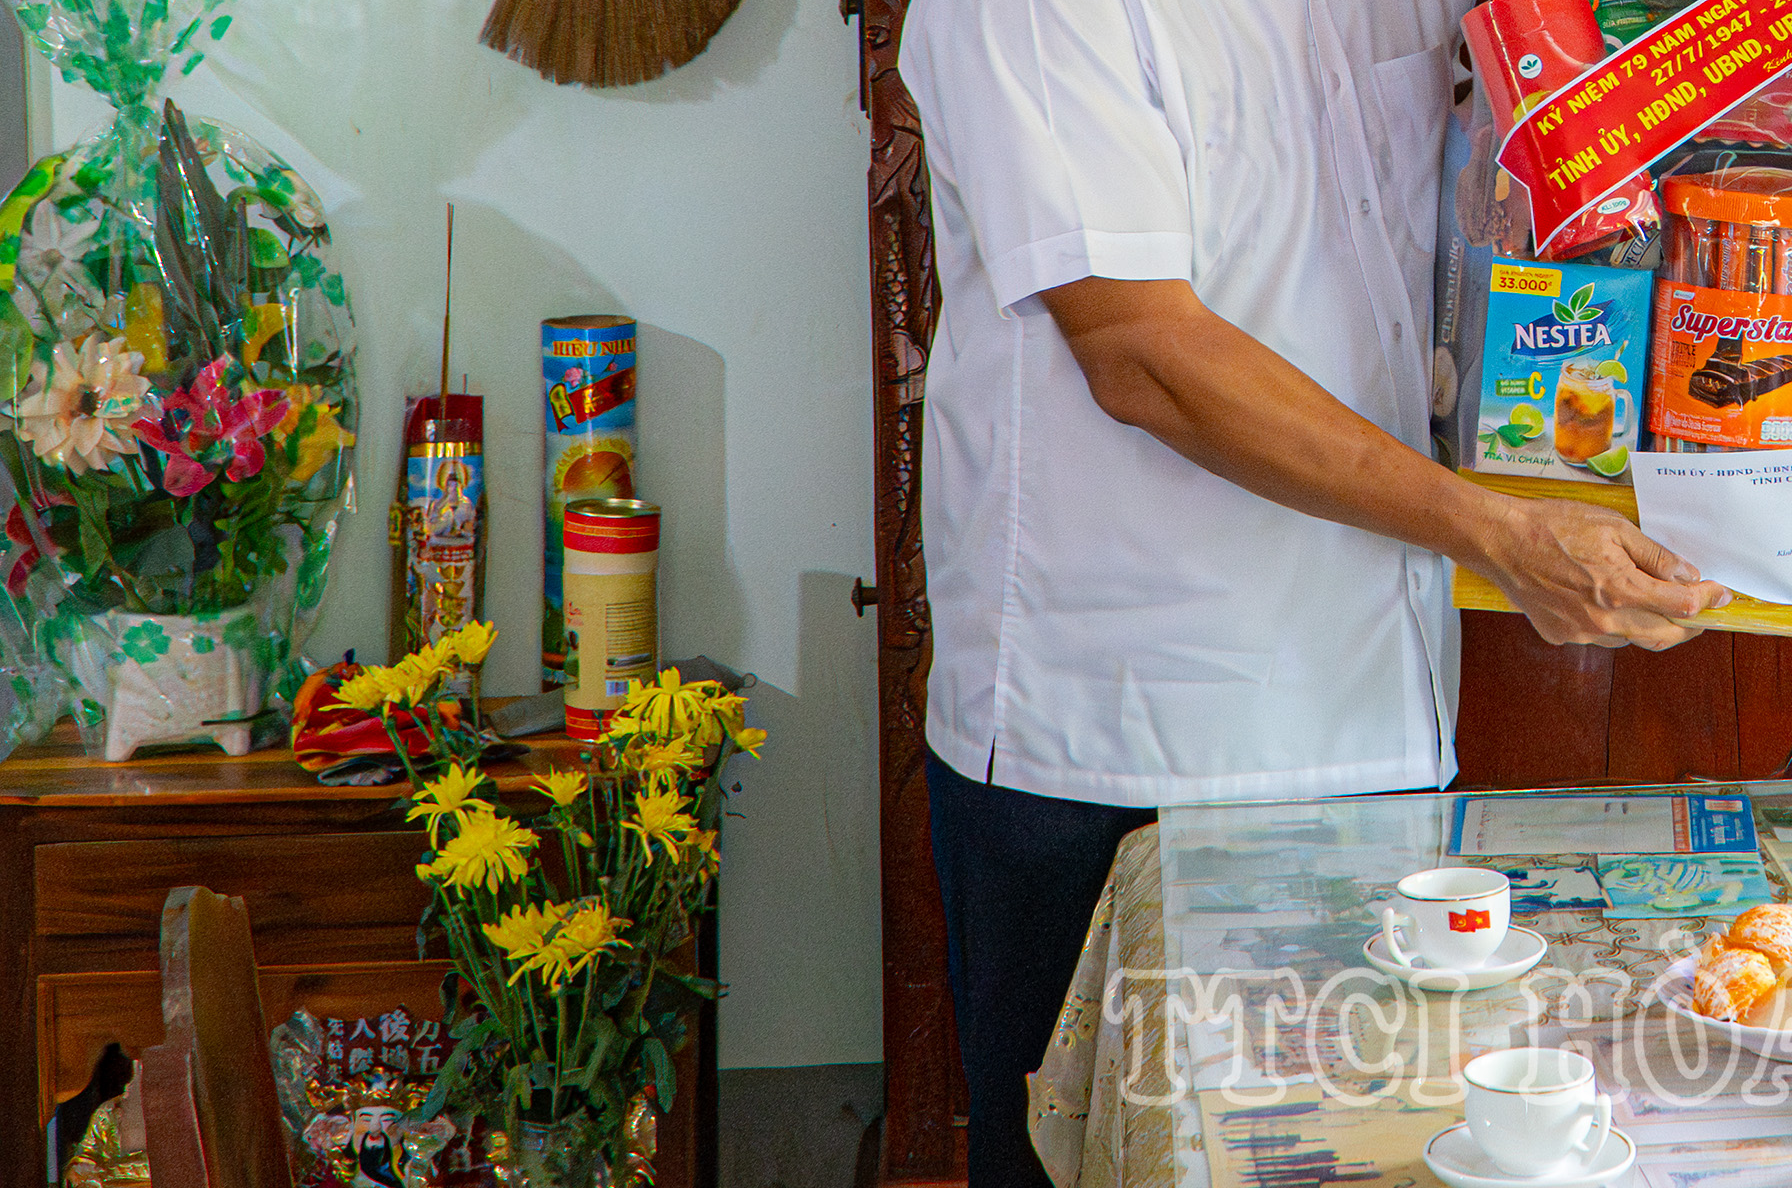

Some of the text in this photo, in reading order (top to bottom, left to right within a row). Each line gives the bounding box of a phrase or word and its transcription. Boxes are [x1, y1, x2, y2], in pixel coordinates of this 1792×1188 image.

[1549, 146, 1602, 189] TỈNH
[1703, 39, 1772, 83] UBND,
[1567, 72, 1620, 114] NIỆM
[1620, 54, 1647, 77] 79
[1649, 23, 1696, 59] NĂM
[1513, 322, 1612, 350] NESTEA
